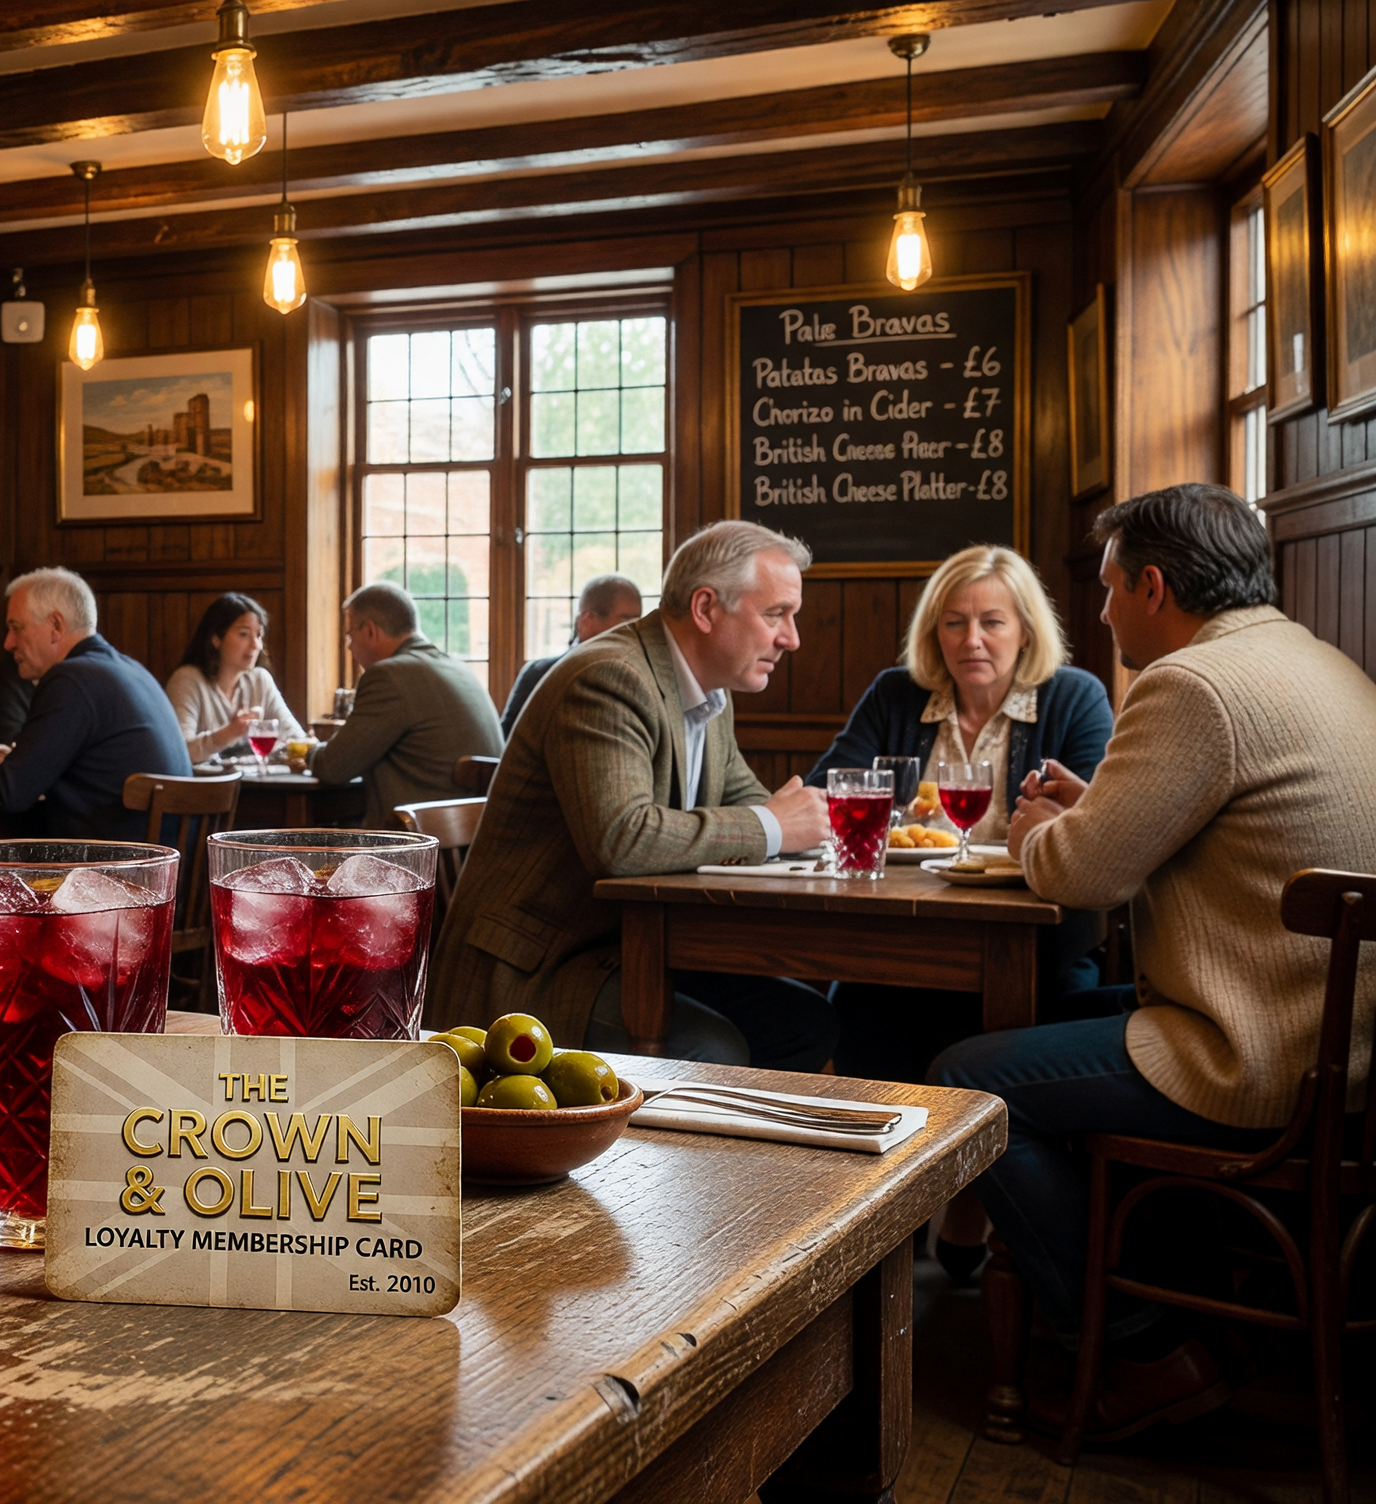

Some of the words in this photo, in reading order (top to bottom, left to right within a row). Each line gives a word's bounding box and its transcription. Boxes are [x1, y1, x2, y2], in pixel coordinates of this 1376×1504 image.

[848, 304, 951, 338] Bravas
[752, 356, 838, 389] Patatas
[846, 352, 929, 384] Bravas
[963, 345, 1001, 378] £6
[752, 396, 834, 427] Chorizo
[843, 399, 863, 422] in
[870, 389, 933, 421] Cider
[963, 386, 1001, 418] £7
[753, 433, 827, 466] British
[754, 473, 828, 507] British
[832, 472, 898, 503] Cheese
[219, 1073, 289, 1102] THE
[122, 1106, 382, 1166] CROWN
[119, 1164, 166, 1215] &
[183, 1165, 383, 1224] OLIVE
[85, 1227, 185, 1249] LOYALTY
[192, 1230, 349, 1256] MEMBERSHIP
[356, 1238, 423, 1259] CARD
[349, 1274, 380, 1292] Est.
[387, 1275, 436, 1294] 2010
